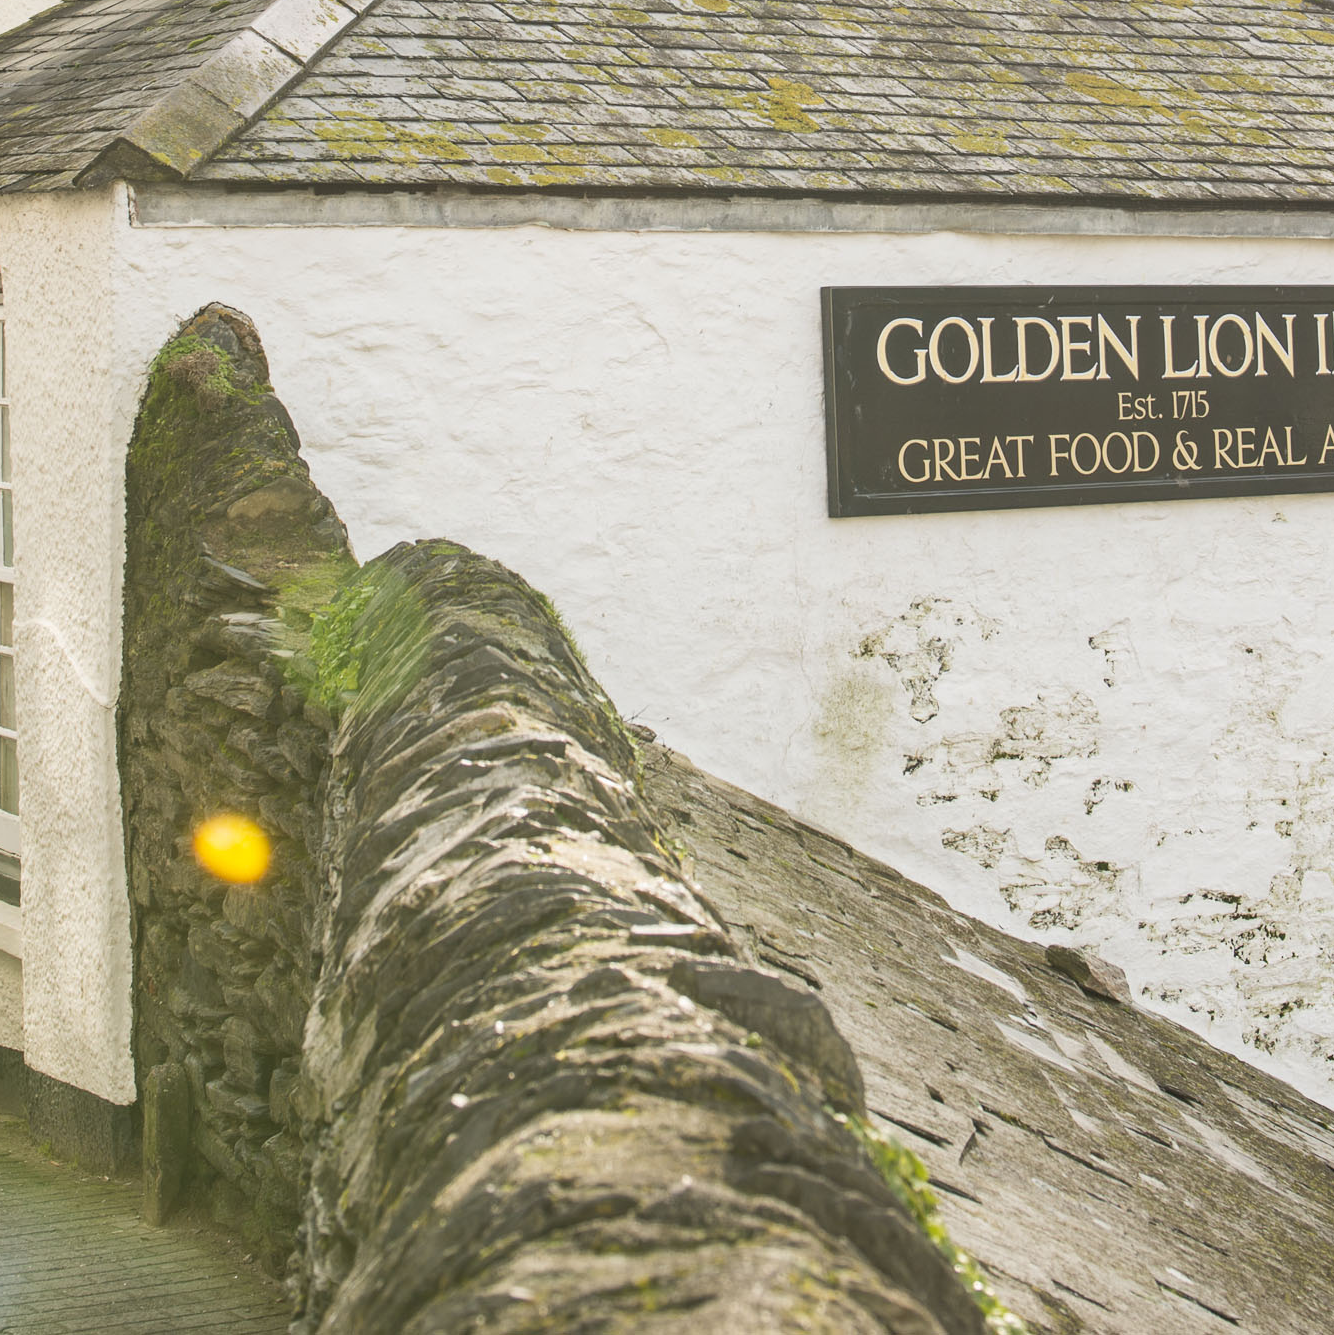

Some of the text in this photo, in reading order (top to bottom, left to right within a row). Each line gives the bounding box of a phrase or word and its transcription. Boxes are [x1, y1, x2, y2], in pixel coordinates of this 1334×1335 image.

[876, 313, 1142, 385] GOLDEN
[1159, 311, 1297, 380] LION
[1117, 390, 1210, 421] Est. 1715
[898, 434, 1035, 483] GREAT
[1048, 431, 1161, 476] FOOD
[1172, 429, 1204, 471] &
[1212, 425, 1308, 469] REAL
